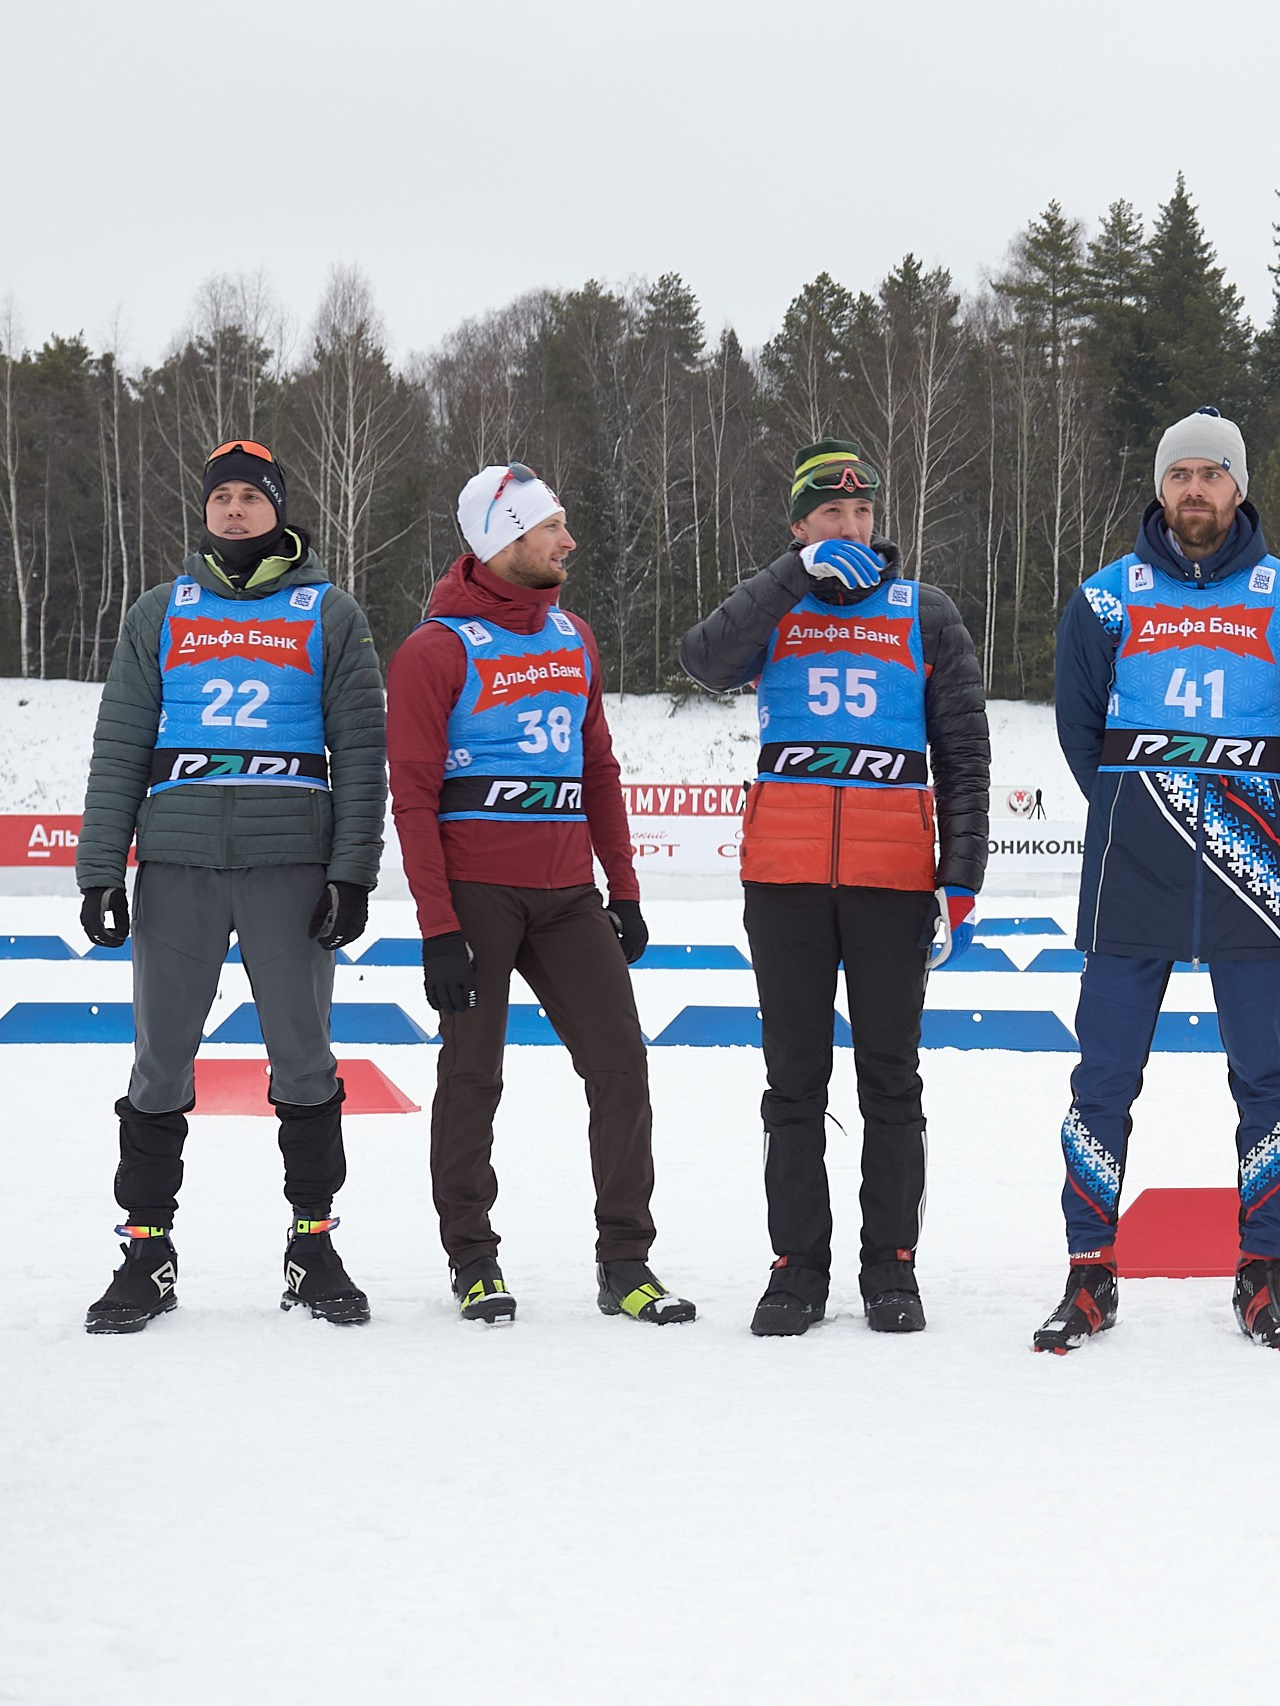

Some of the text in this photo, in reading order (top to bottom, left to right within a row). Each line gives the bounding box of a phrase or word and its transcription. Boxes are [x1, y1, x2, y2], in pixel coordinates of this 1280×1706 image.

[1253, 581, 1269, 590] 2025
[180, 630, 298, 650] Альфа Банк
[787, 624, 901, 646] Альфа Банк
[1140, 618, 1257, 639] Альфа Банк
[493, 662, 583, 689] Альфа Банк
[201, 678, 270, 728] 22
[808, 668, 877, 718] 55
[1164, 668, 1225, 718] 41
[517, 706, 572, 754] 38
[774, 747, 906, 780] PARI
[1126, 734, 1266, 766] PARI
